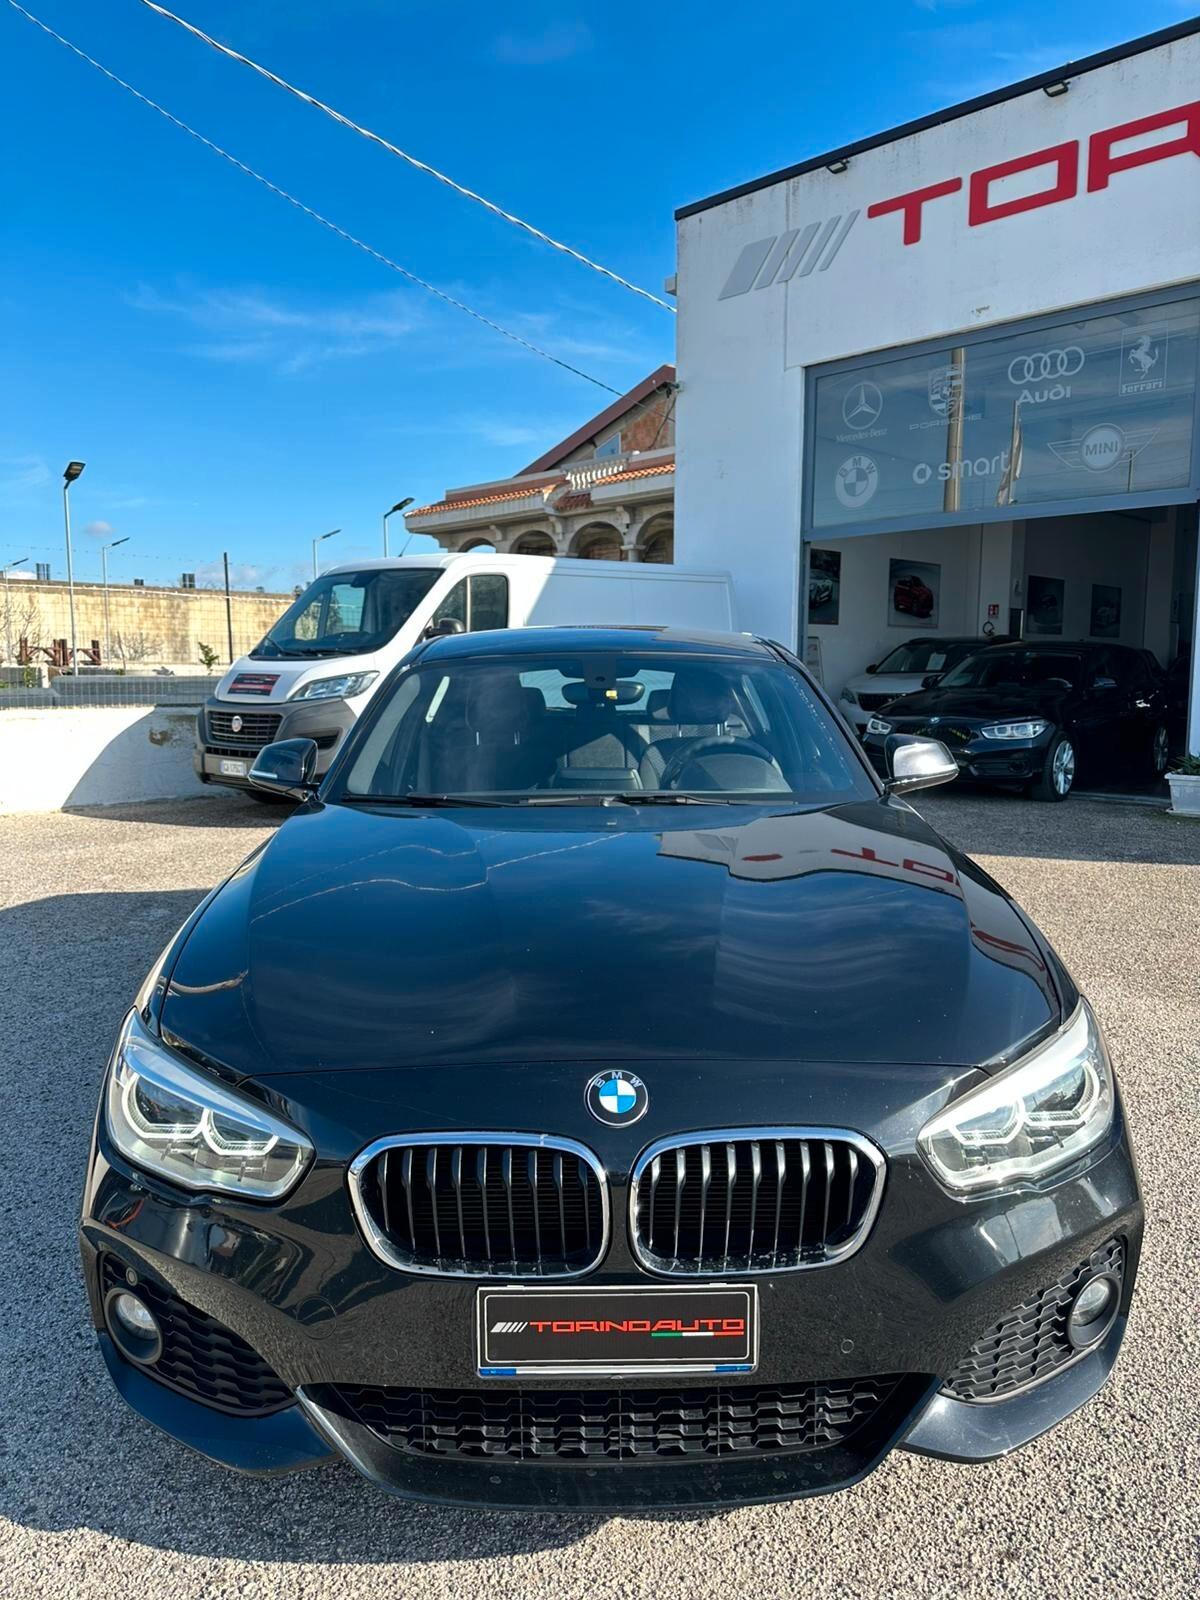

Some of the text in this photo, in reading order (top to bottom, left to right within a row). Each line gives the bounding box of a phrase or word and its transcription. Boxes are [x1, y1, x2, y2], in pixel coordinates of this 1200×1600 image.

[1018, 384, 1071, 404] Audi
[1121, 379, 1163, 394] Ferrari
[909, 413, 982, 430] PORSCHE
[836, 428, 888, 442] Mercedes-Benz
[1085, 440, 1119, 457] MINI
[838, 456, 877, 479] BMW
[937, 450, 1011, 481] smart
[594, 1071, 643, 1088] BMW
[529, 1318, 745, 1333] TORINOAUTO
